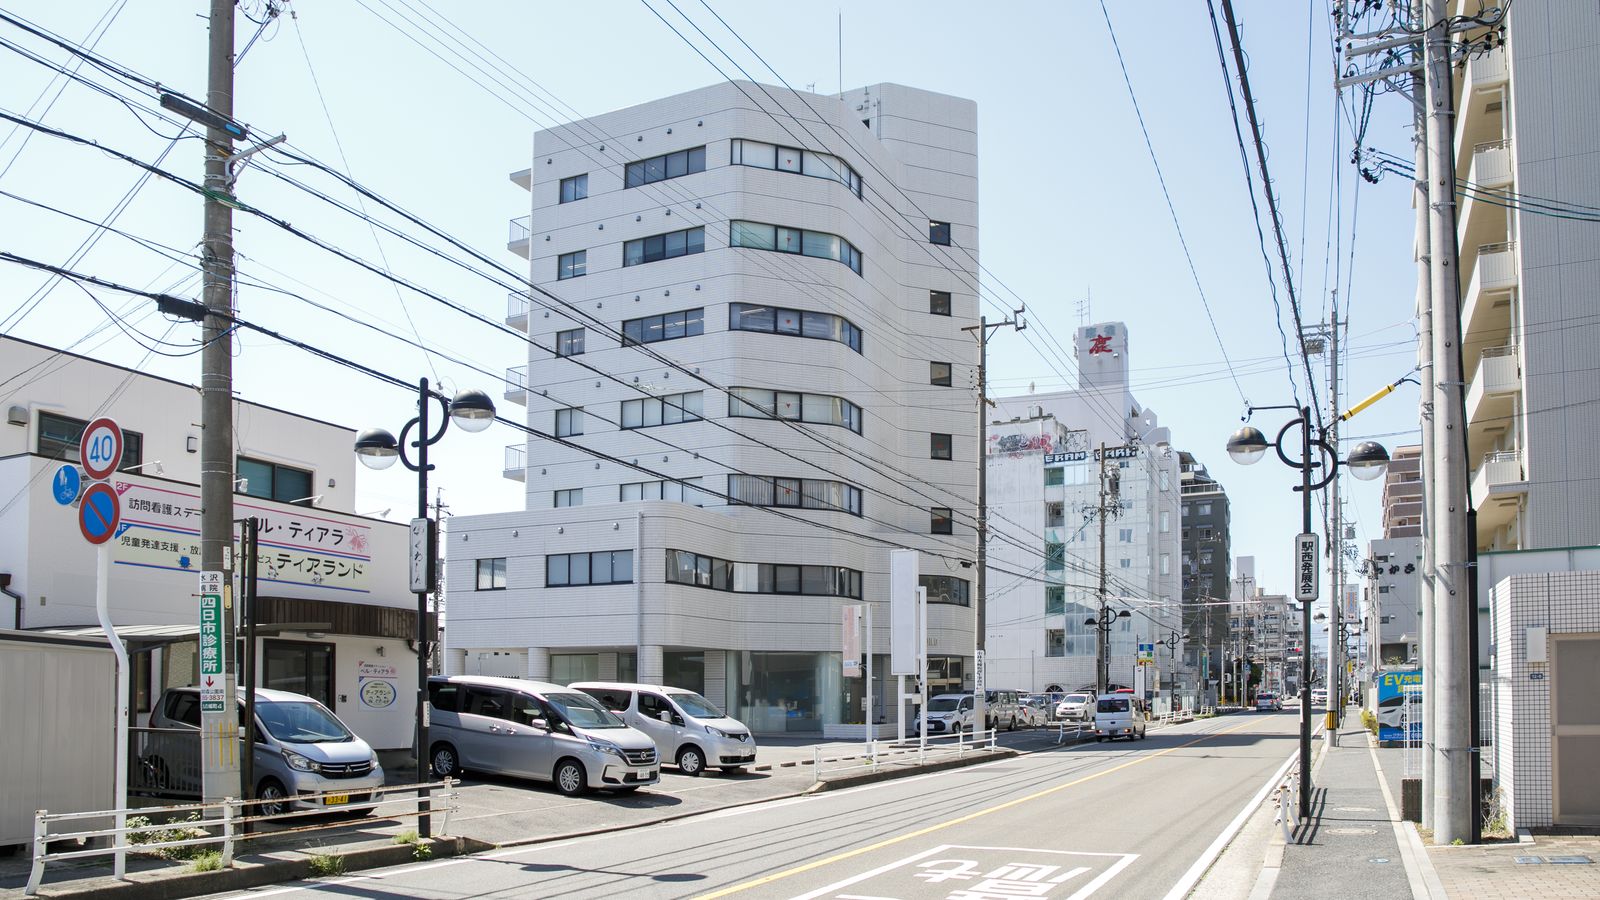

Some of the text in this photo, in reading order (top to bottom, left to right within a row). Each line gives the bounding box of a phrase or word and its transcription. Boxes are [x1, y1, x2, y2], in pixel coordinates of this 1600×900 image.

[89, 435, 113, 462] 40
[121, 536, 201, 555] 児童発達支援・放
[277, 553, 363, 579] ティアランド
[1300, 541, 1314, 594] 駅西発展会
[202, 597, 217, 672] 四日市診療所
